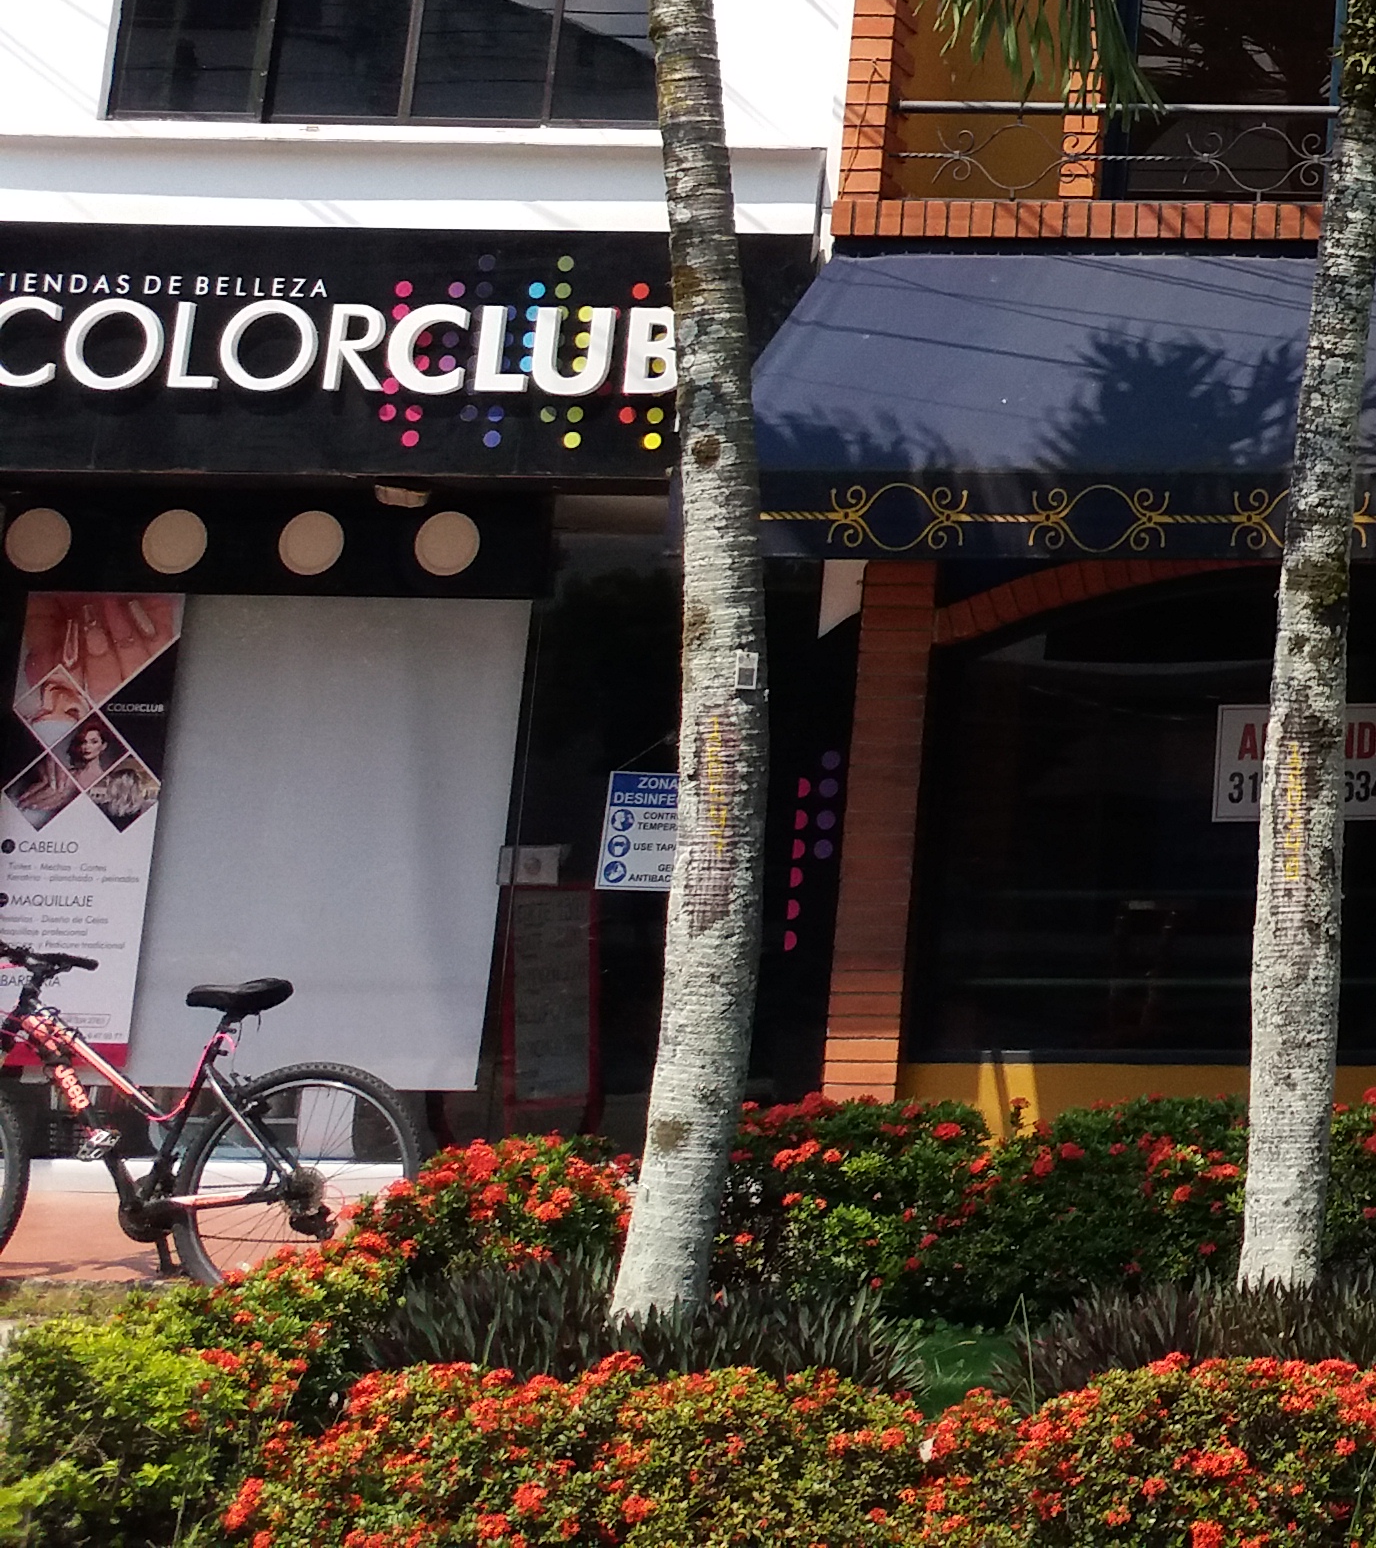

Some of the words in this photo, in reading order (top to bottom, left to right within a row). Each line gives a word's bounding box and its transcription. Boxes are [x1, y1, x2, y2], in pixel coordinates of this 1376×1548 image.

[143, 275, 182, 295] DE
[194, 276, 328, 298] BELLEZA
[0, 295, 679, 396] COLORCLUB
[637, 776, 679, 789] ZONA
[613, 791, 678, 805] DESINFE
[18, 840, 79, 854] CABELLO
[633, 843, 653, 851] USE
[11, 894, 94, 907] MAQUILLAJE
[55, 1064, 90, 1109] Jeep
